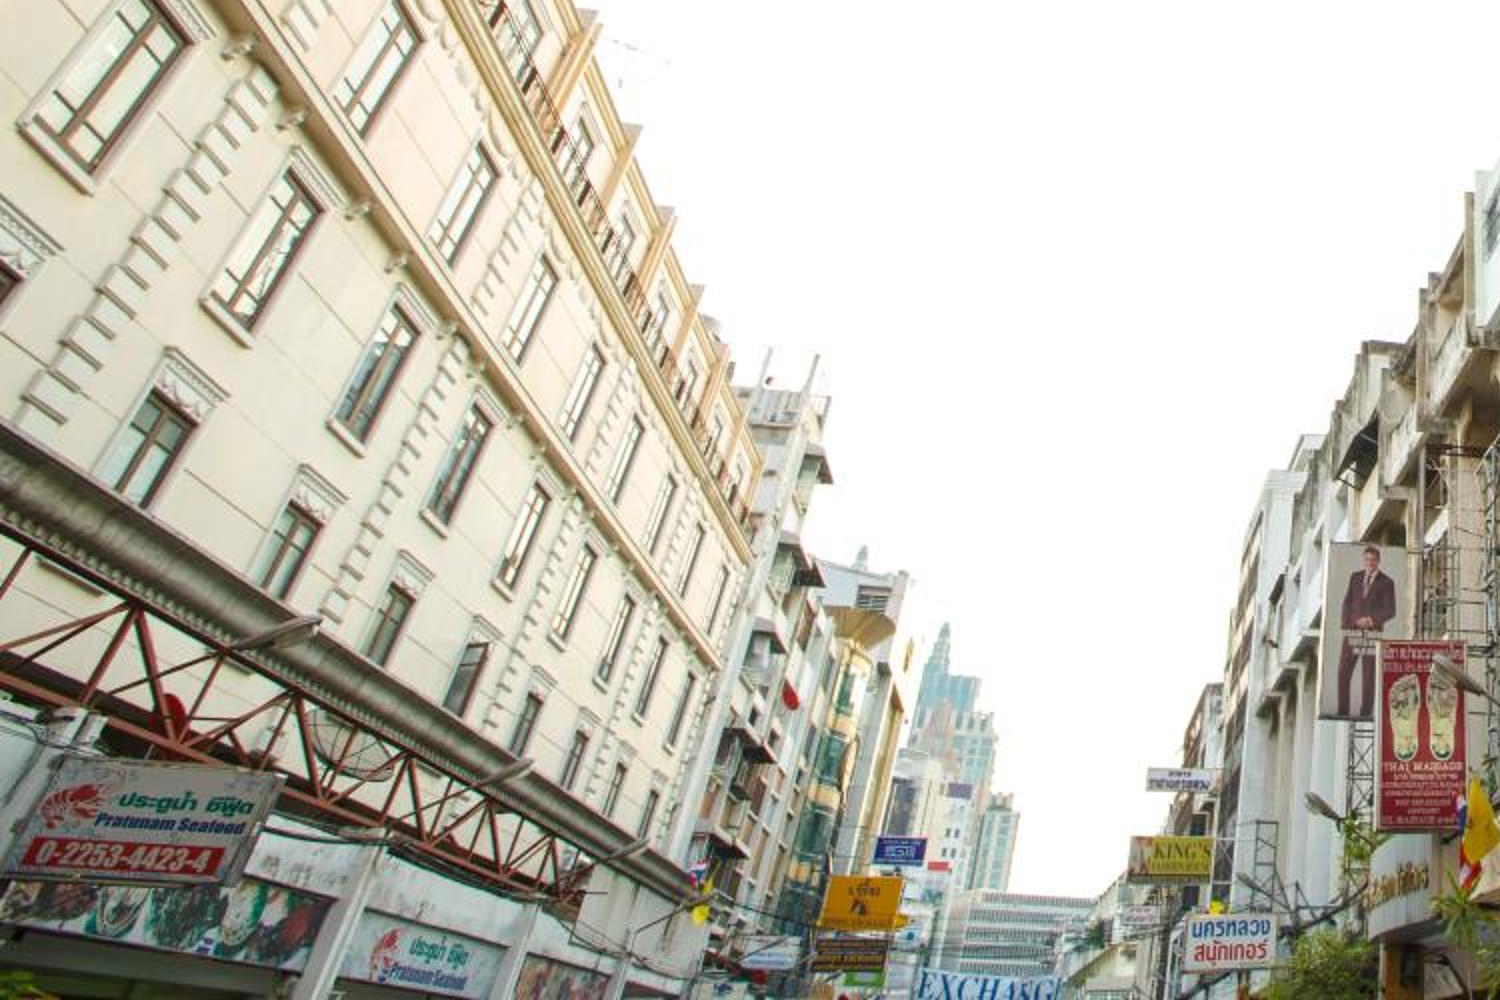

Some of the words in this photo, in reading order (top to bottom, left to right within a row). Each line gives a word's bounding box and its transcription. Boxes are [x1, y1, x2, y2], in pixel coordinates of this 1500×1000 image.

[94, 812, 177, 831] Pratunam
[177, 816, 246, 836] Seafood
[34, 840, 208, 870] 0-2253-4423-4
[1192, 919, 1271, 939] นครหลวง
